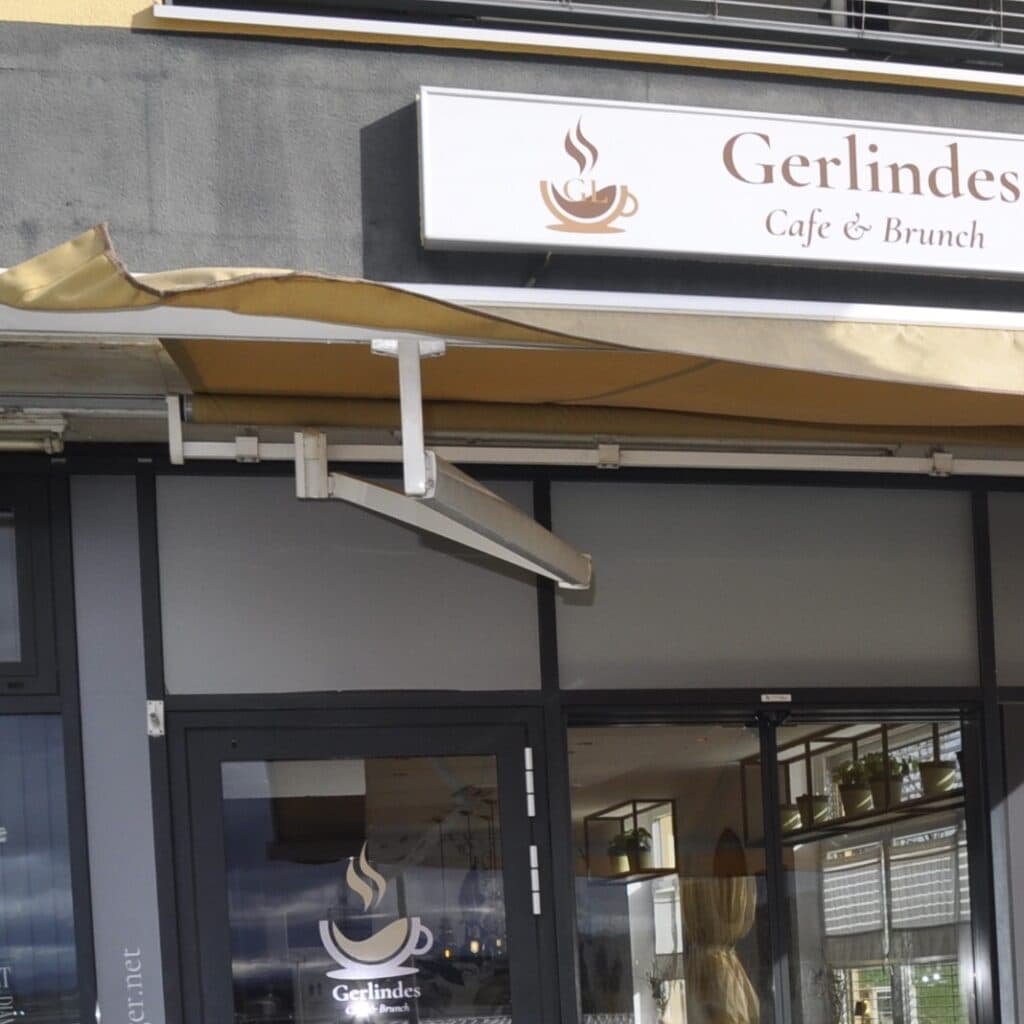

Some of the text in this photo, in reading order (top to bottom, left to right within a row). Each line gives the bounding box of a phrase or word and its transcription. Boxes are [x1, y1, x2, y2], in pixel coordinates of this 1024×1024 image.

[722, 131, 1021, 203] Gerlindes
[765, 208, 985, 249] Cafe & Brunch
[332, 981, 421, 1001] Gerlindes
